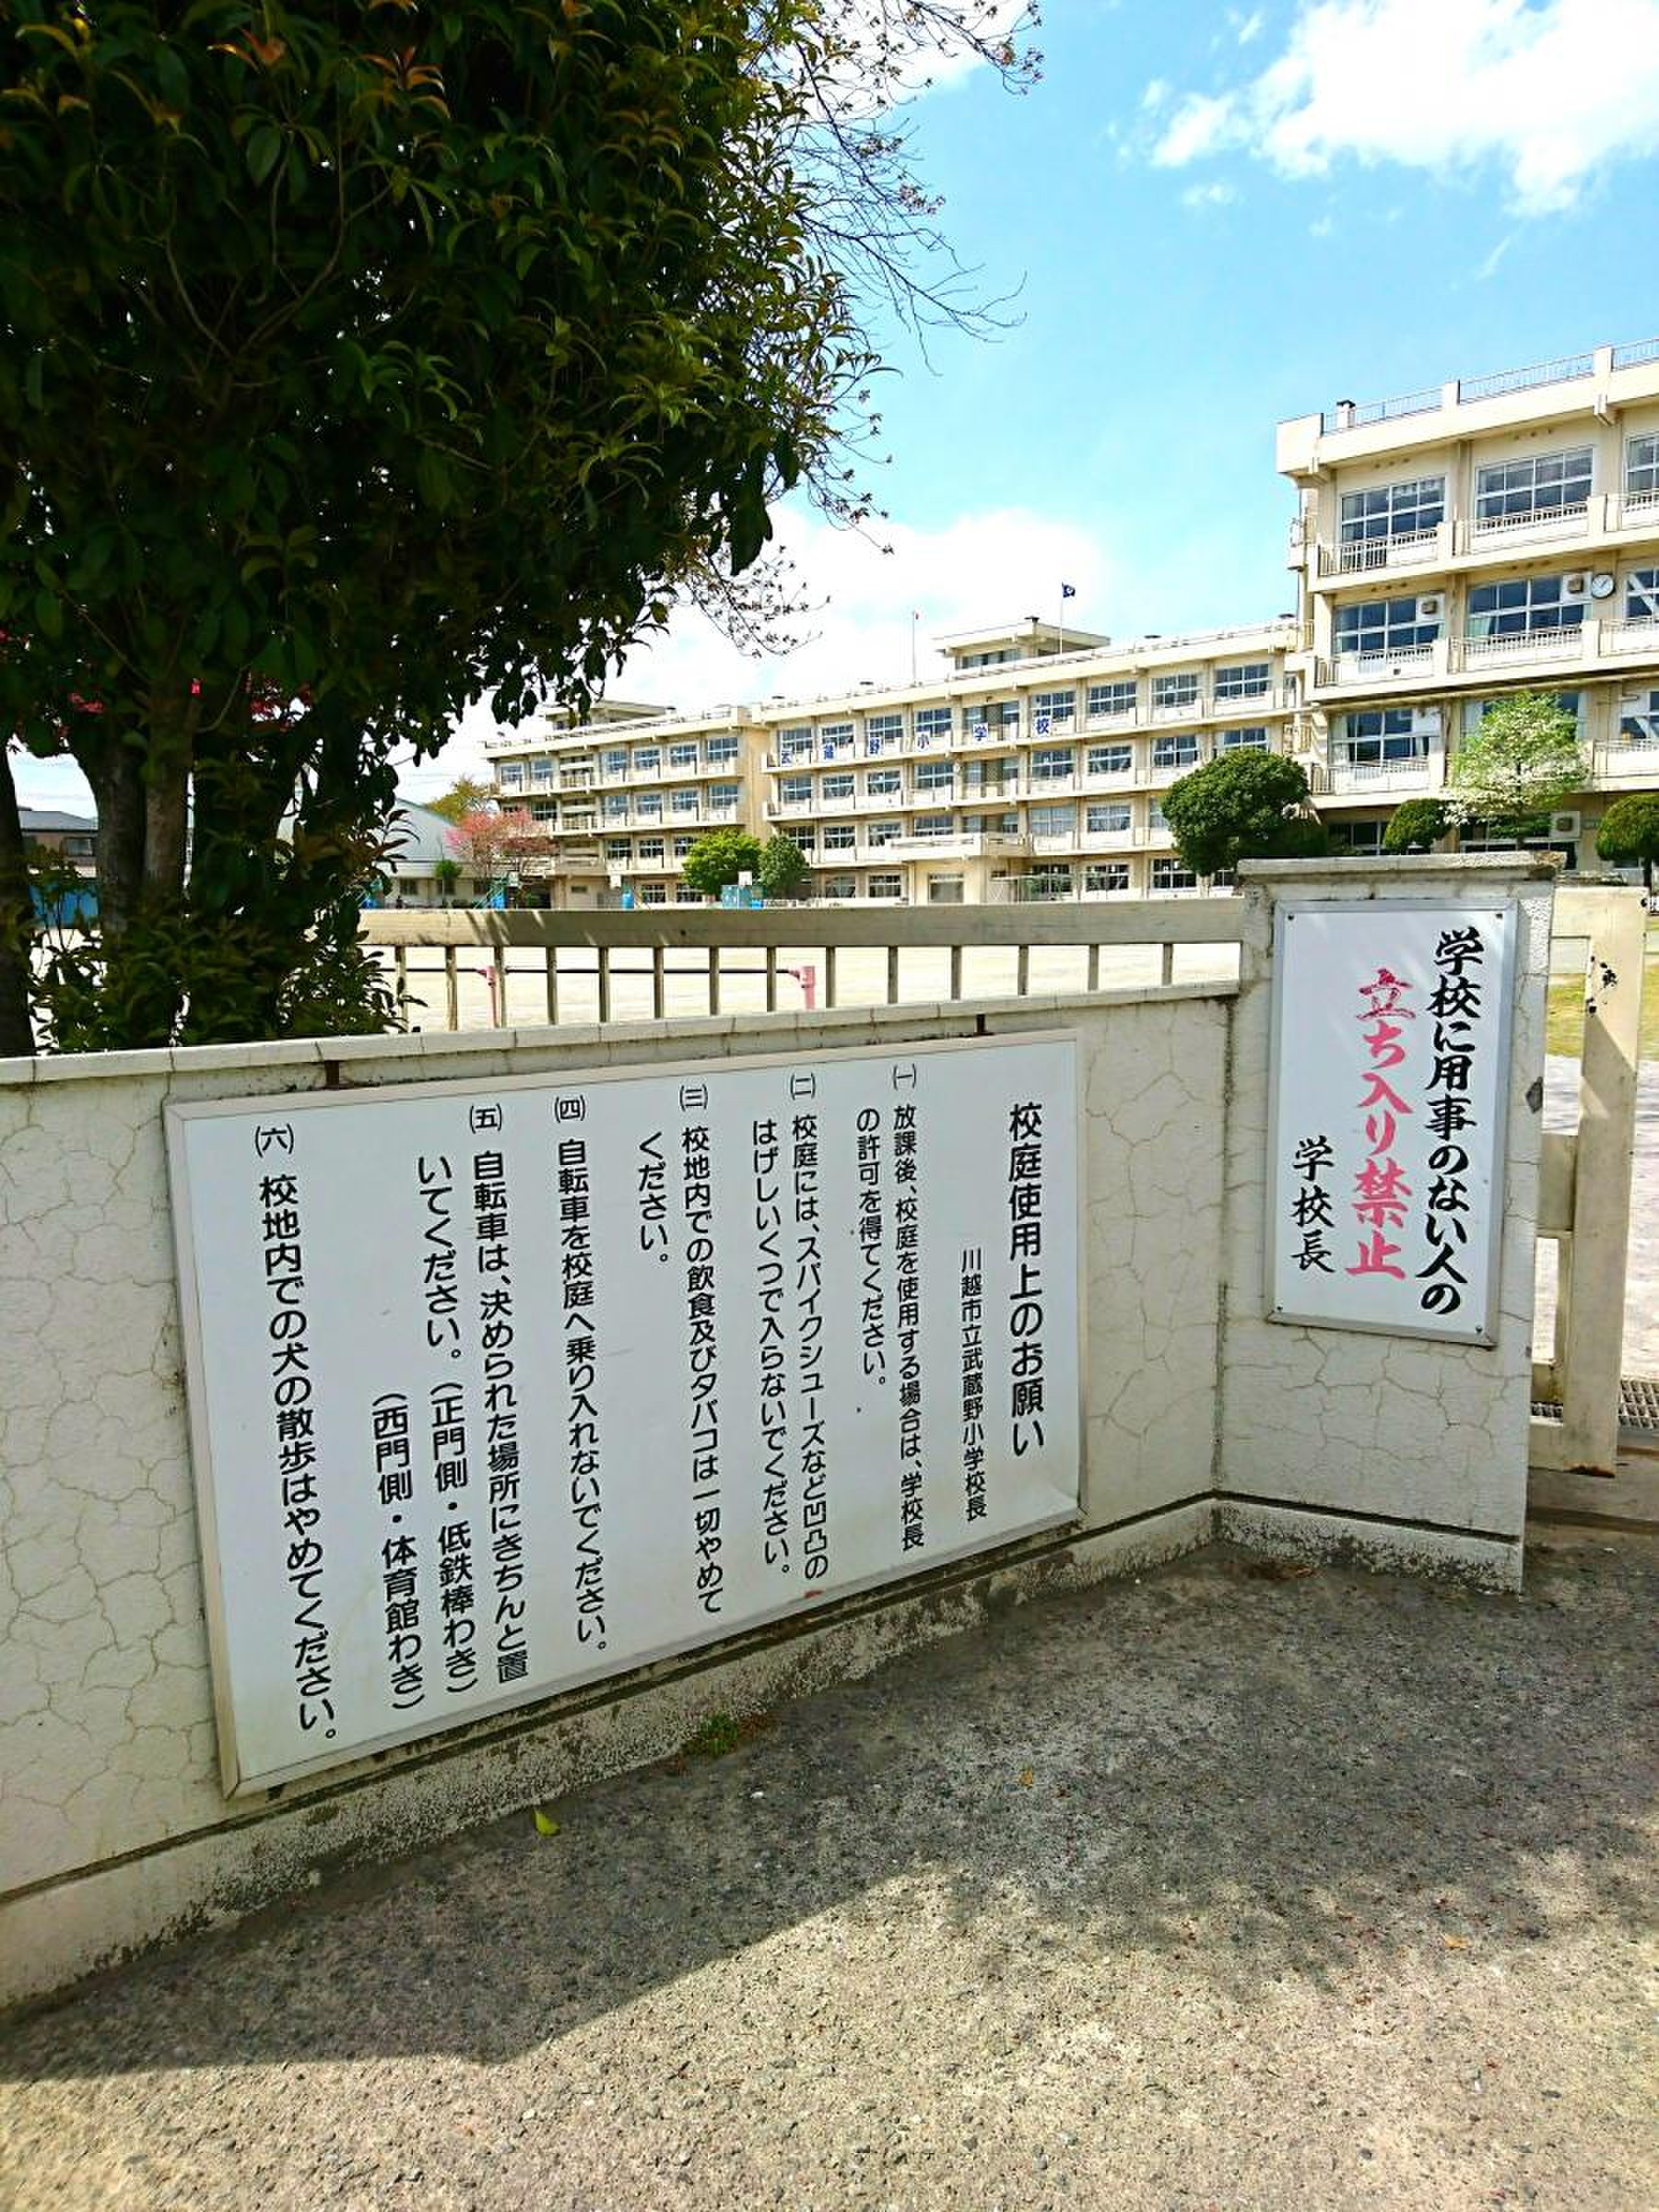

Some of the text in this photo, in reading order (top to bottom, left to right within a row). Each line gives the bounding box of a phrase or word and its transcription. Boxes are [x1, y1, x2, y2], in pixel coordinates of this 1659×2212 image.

[637, 1130, 670, 1264] ください。
[855, 1107, 887, 1386] の許可を得てください。
[1289, 1134, 1336, 1275] 学校長
[1344, 966, 1418, 1282] 立ち入り禁止
[1414, 924, 1486, 1316] 学校に用事のない人の
[751, 1117, 792, 1575] はげしいくつで入らないでください。
[959, 1246, 989, 1524] 川越市立武蔵野小学校長
[1006, 1100, 1046, 1458] 校庭使用上のお願い
[371, 1392, 427, 1711] （西門側・体育館わき）
